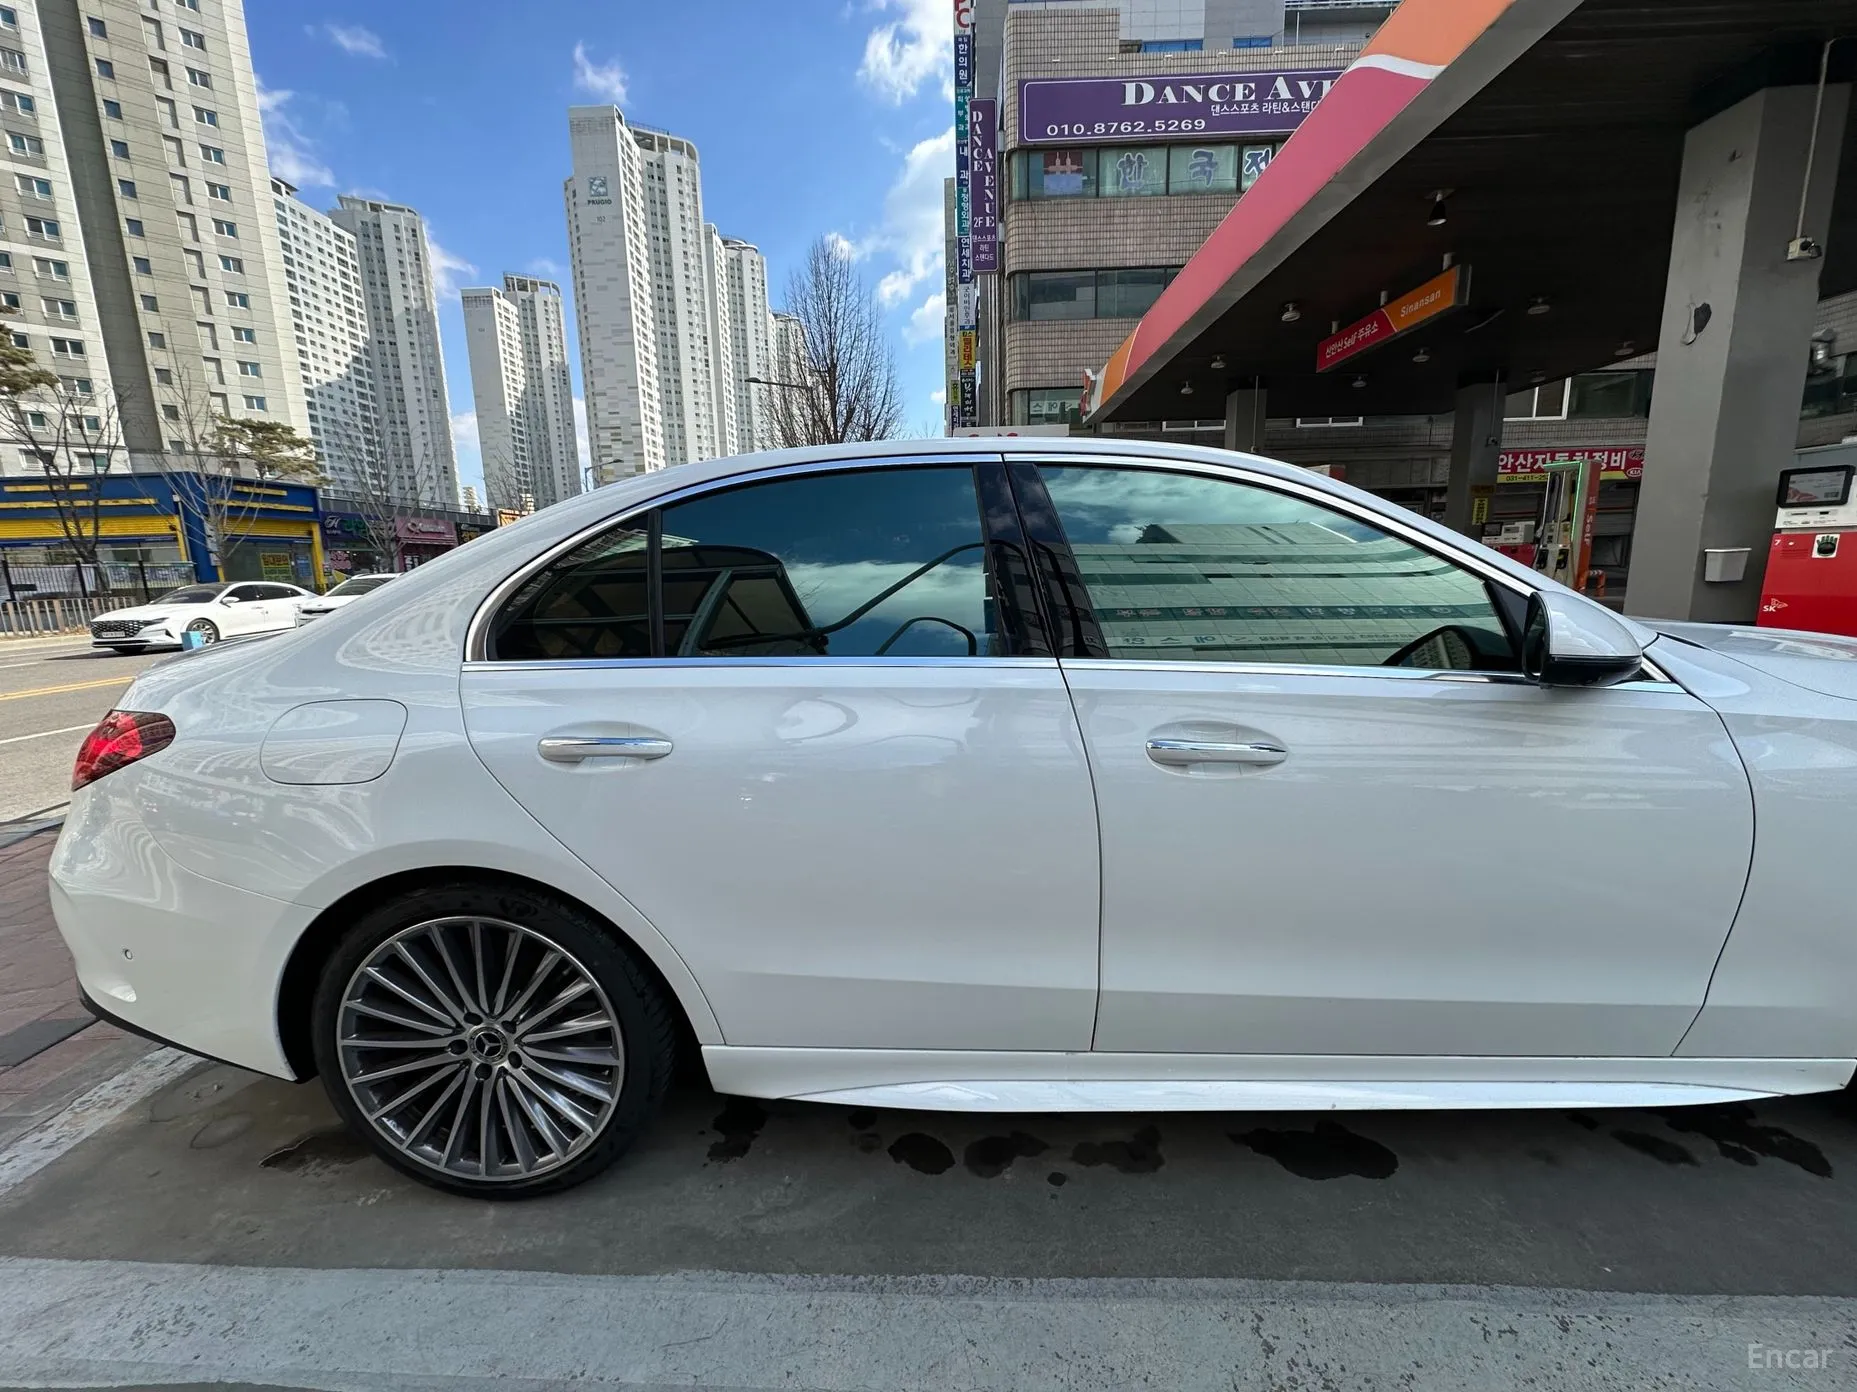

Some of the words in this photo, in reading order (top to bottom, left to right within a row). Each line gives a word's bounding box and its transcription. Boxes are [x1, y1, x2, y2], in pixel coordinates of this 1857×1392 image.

[959, 43, 968, 80] 한의원
[1121, 81, 1255, 105] DANCE
[1211, 101, 1259, 116] 댄스스포츠
[972, 110, 983, 171] DANCE
[1046, 118, 1206, 137] 010.8762.5269
[984, 147, 995, 228] AVENUE
[973, 216, 983, 228] 2F
[961, 237, 970, 278] 연세치과
[1400, 289, 1441, 317] Sinansan
[1358, 320, 1379, 341] 주유소
